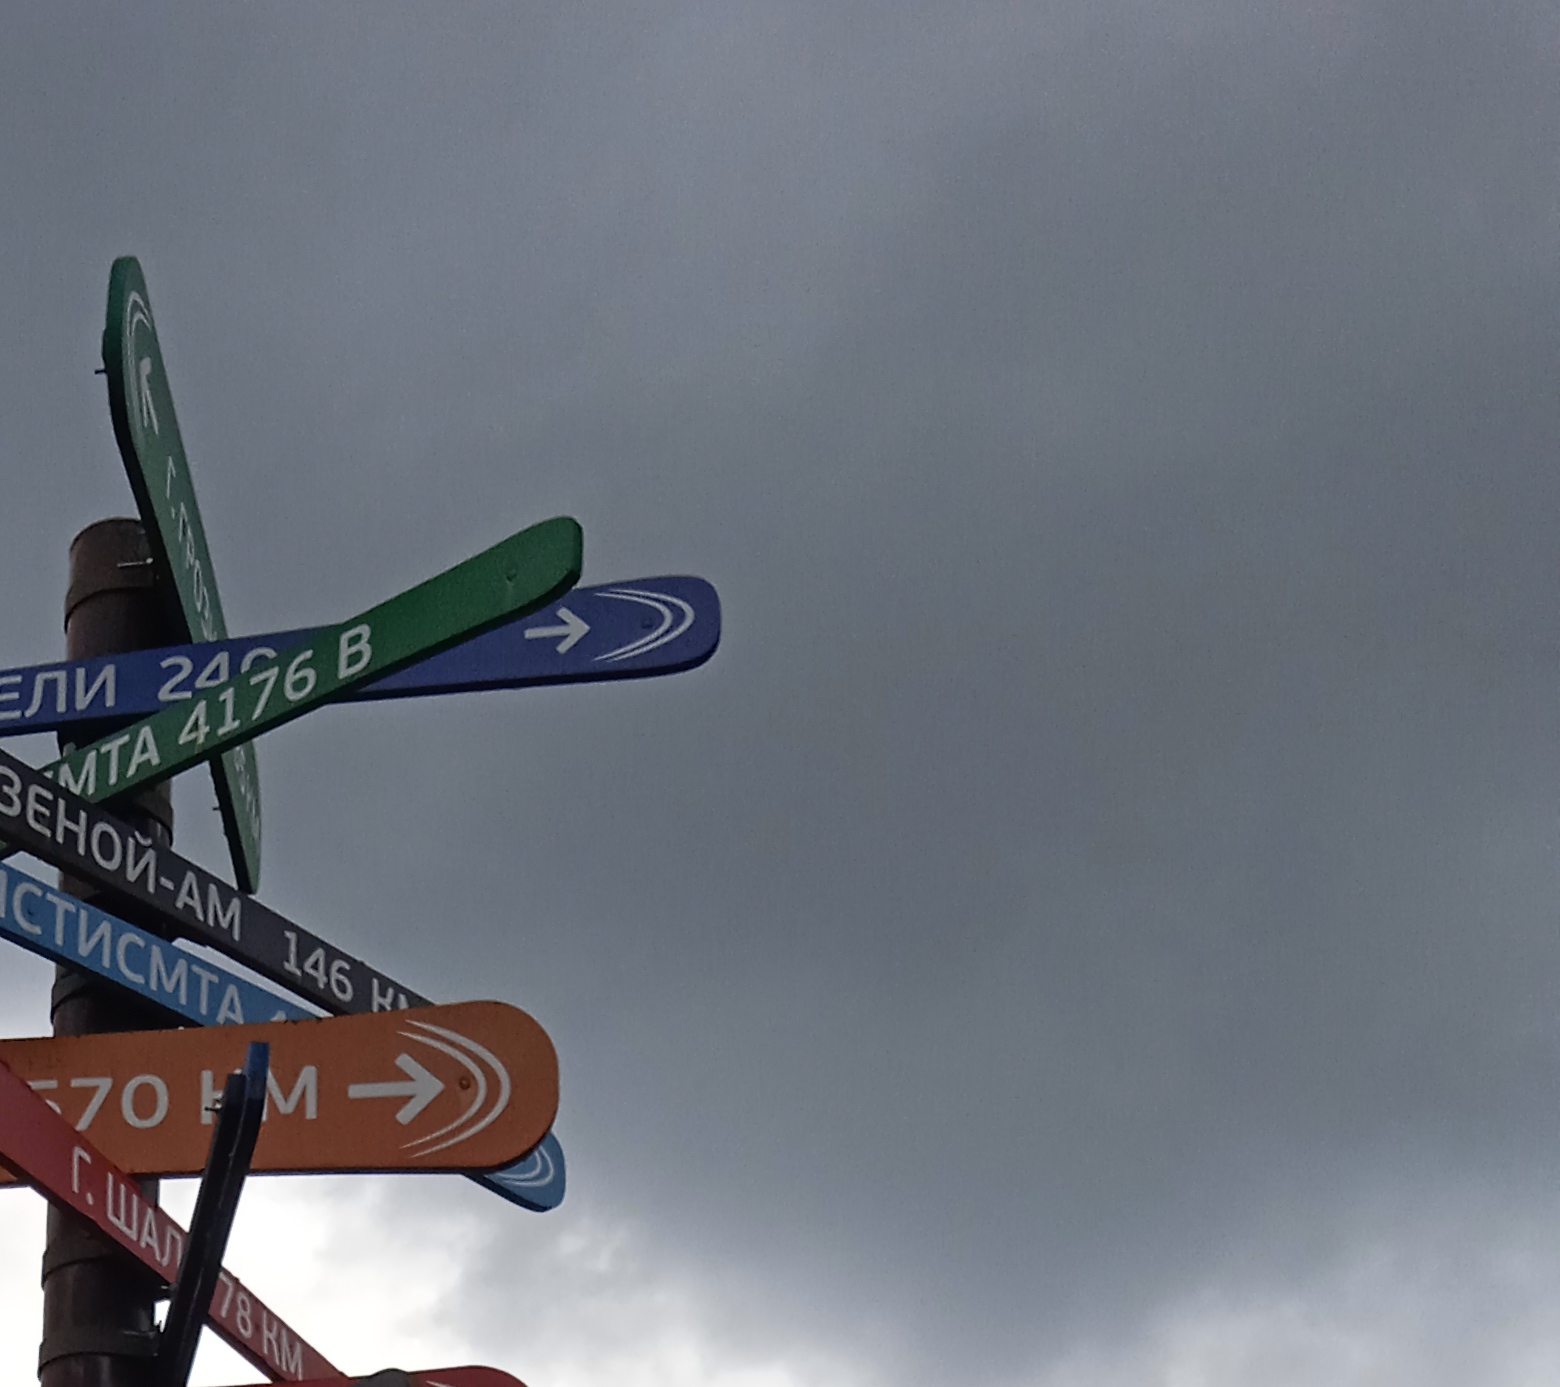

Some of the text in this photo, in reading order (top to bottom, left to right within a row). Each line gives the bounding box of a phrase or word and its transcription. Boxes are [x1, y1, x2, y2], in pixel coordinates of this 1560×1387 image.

[177, 648, 317, 747] 4176
[337, 623, 373, 680] В
[282, 930, 354, 1003] 146
[71, 1145, 94, 1206] Г.
[106, 1171, 184, 1268] ШАЛ
[262, 1311, 305, 1382] КМ
